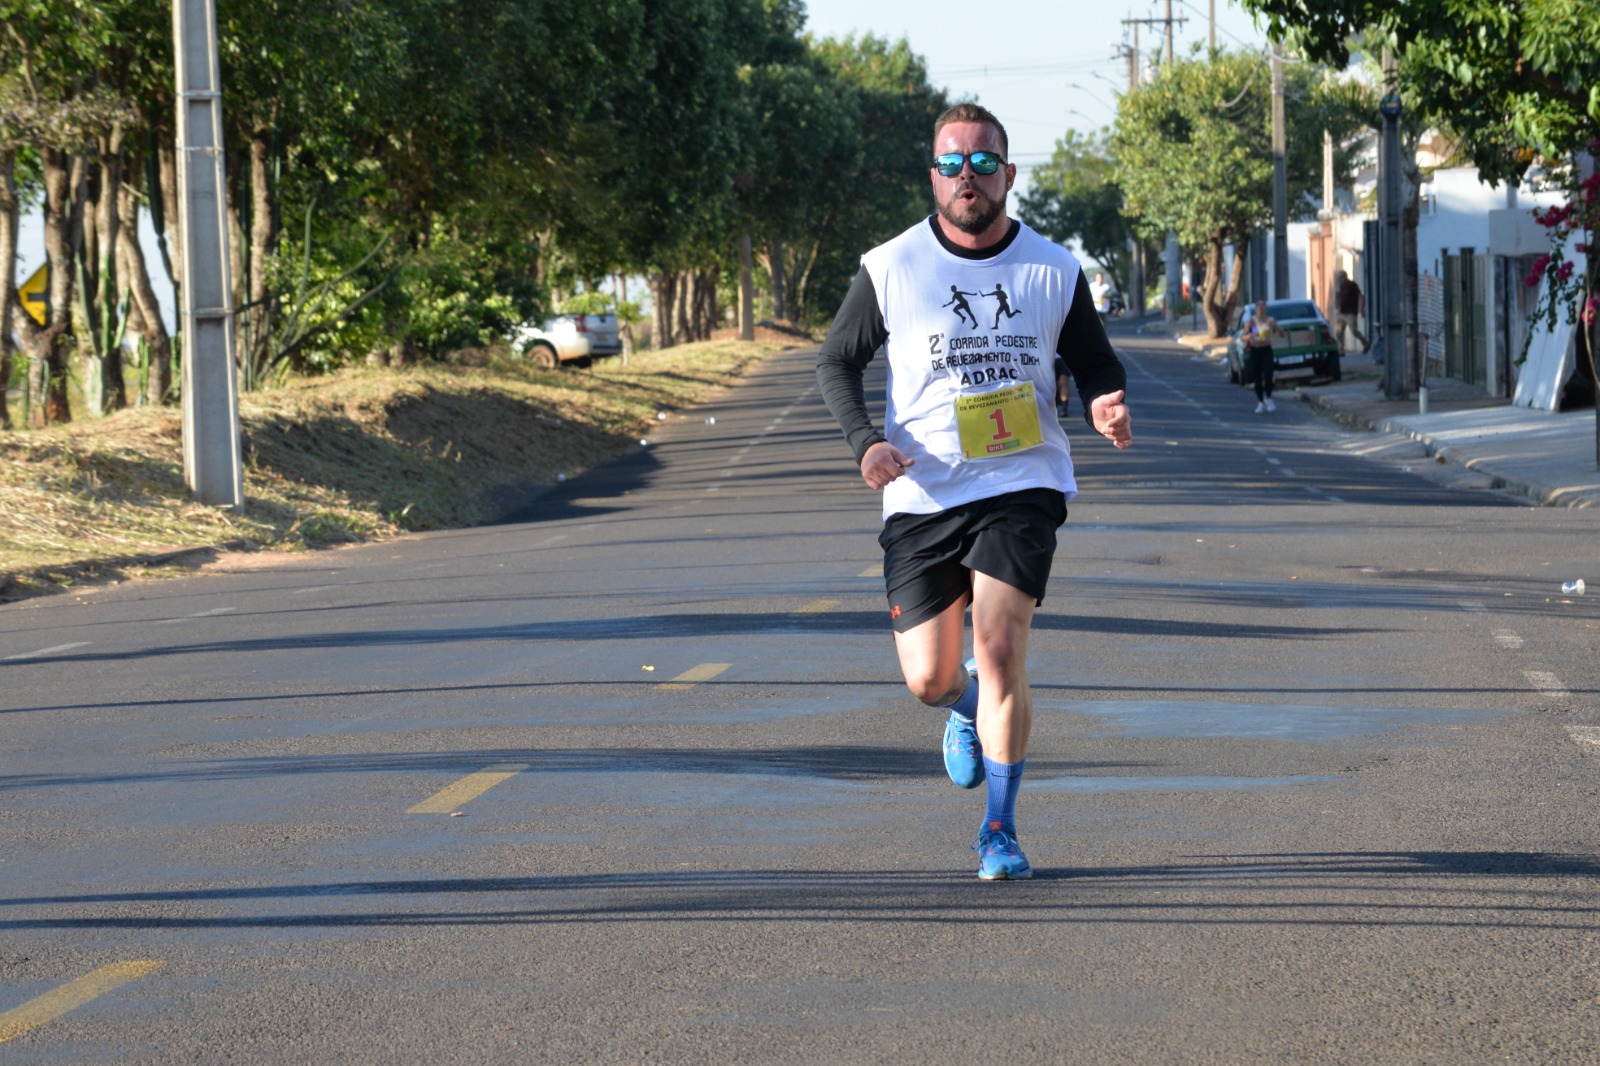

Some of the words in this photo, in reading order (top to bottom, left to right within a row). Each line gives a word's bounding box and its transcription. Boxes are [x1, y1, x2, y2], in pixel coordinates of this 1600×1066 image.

[949, 335, 989, 351] CORRIDA
[995, 335, 1038, 349] PEDESTRE
[931, 358, 946, 371] DE
[1020, 353, 1040, 366] 10KM
[961, 367, 1018, 386] ADRAC
[973, 394, 999, 403] CORRIDA
[989, 408, 1012, 440] 1
